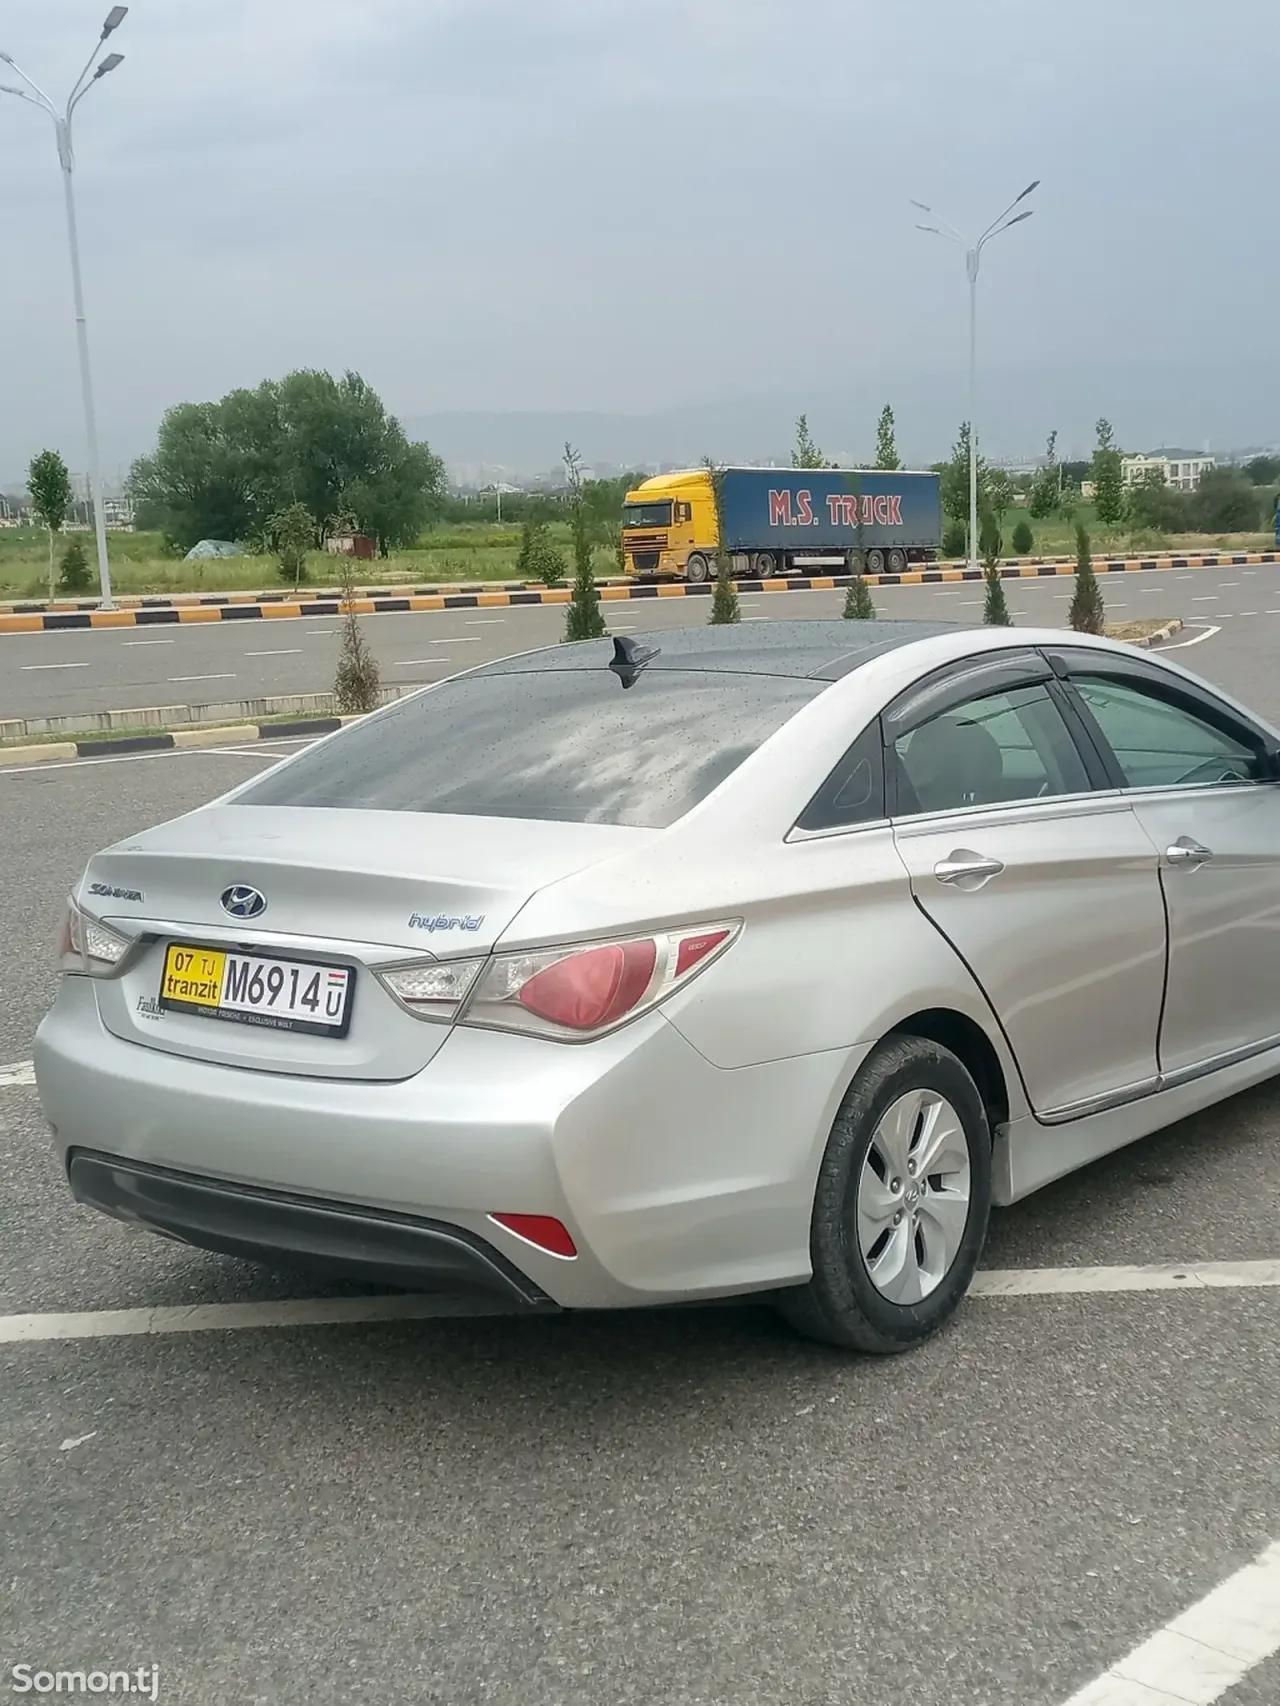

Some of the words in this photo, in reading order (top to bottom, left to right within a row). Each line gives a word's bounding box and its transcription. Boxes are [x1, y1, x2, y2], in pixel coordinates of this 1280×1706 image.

[768, 490, 819, 526] M.S.
[826, 495, 904, 529] TRUCK
[408, 911, 485, 933] hybrid
[175, 952, 194, 971] 07
[202, 958, 216, 976] TJ
[167, 974, 218, 999] tranzit
[224, 959, 321, 1013] M6914
[326, 991, 342, 1017] U
